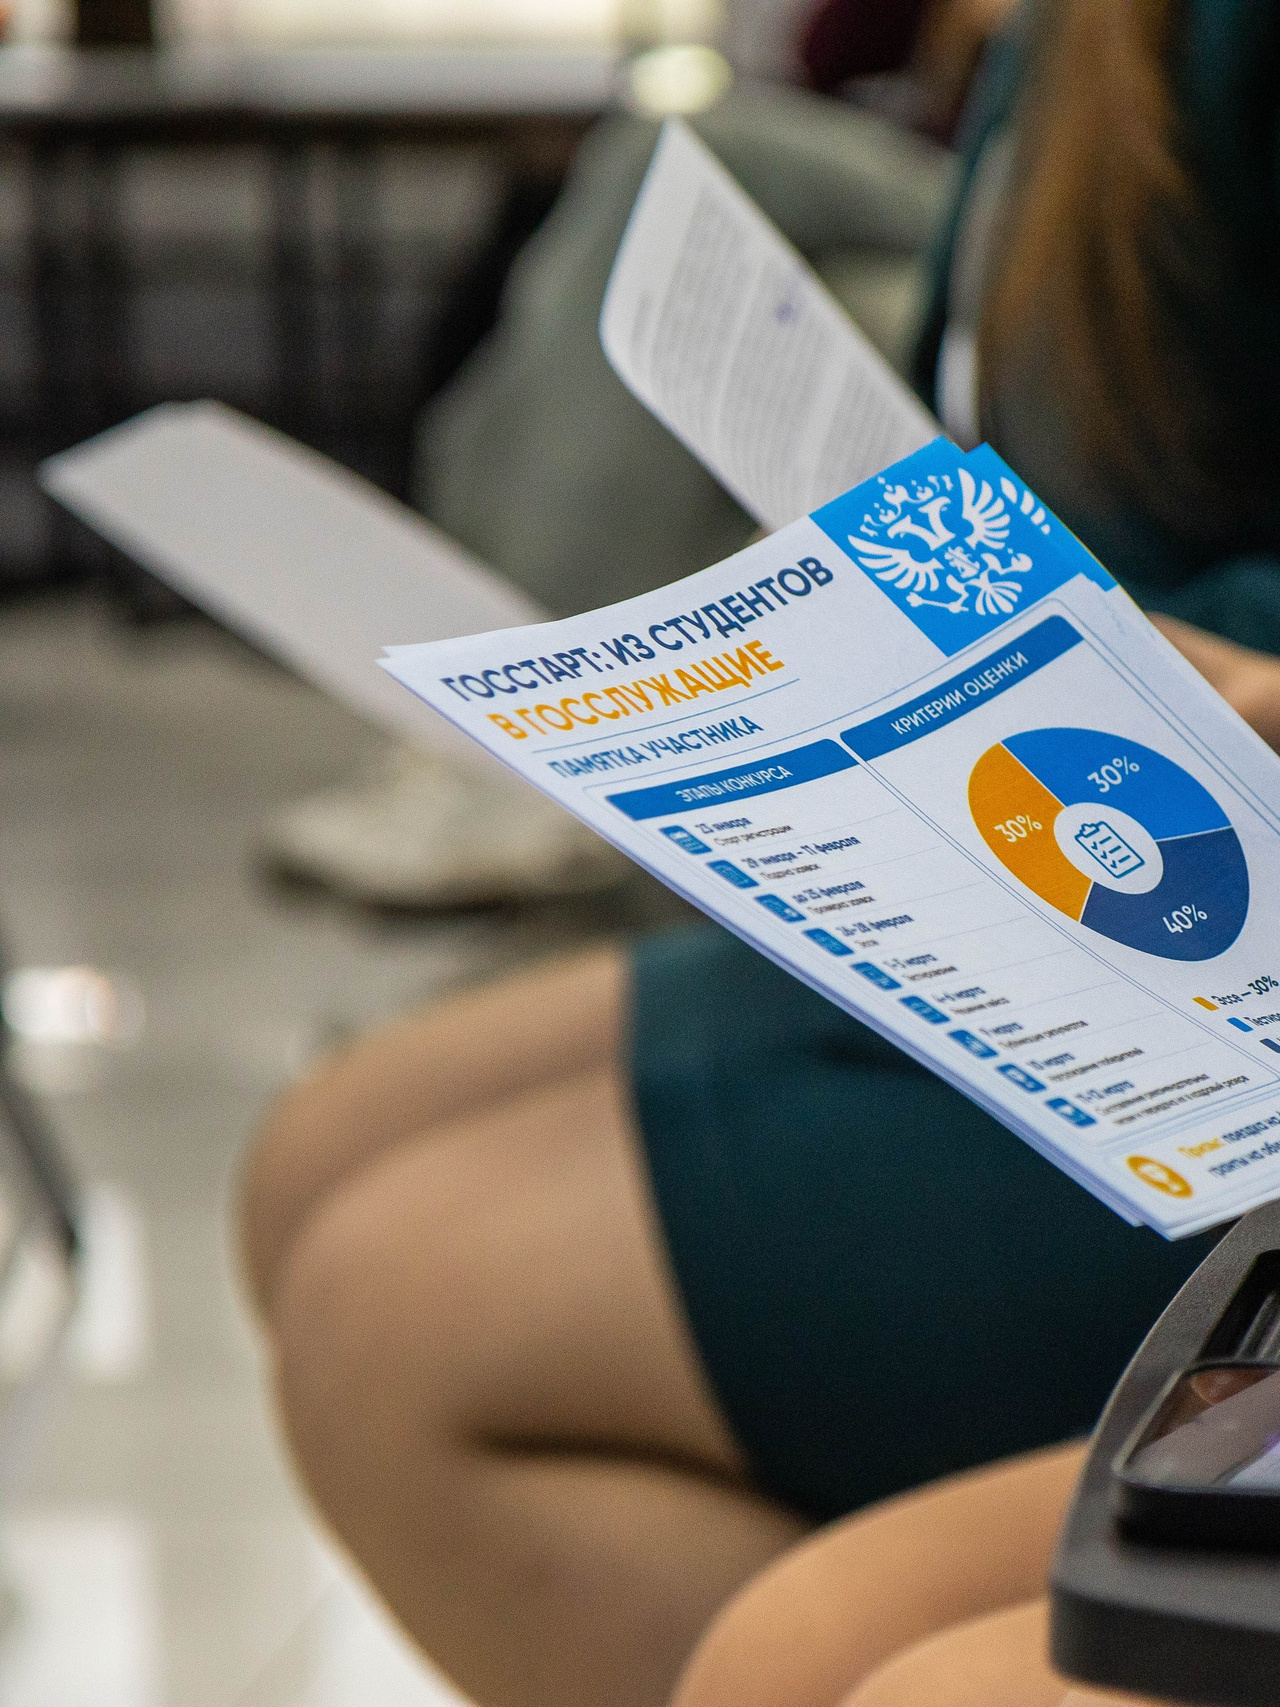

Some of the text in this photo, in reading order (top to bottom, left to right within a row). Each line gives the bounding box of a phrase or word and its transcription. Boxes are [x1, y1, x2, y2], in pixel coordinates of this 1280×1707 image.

[440, 556, 834, 702] ГОССТАРТ: ИЗ СТУДЕНТОВ
[486, 639, 785, 741] В ГОССЛУЖАЩИЕ
[890, 651, 1030, 736] КРИТЕРИИ ОЦЕНКИ
[546, 715, 765, 780] ПАМЯТКА УЧАСТНИКА
[675, 765, 794, 803] ЭТАПЫ КОНКУРСА
[1087, 755, 1141, 793] 30%
[712, 817, 753, 833] января
[743, 824, 793, 842] регистрации
[994, 814, 1043, 844] 30%
[759, 850, 797, 866] января
[814, 836, 861, 854] февраля
[817, 881, 866, 897] февраля
[868, 914, 915, 930] февраля
[1162, 903, 1208, 934] 40%
[904, 954, 937, 967] марта
[1211, 994, 1244, 1005] Эссе
[1247, 975, 1279, 995] 30%
[993, 1022, 1023, 1035] марта
[1222, 1122, 1266, 1142] поездка
[1242, 1150, 1264, 1166] на
